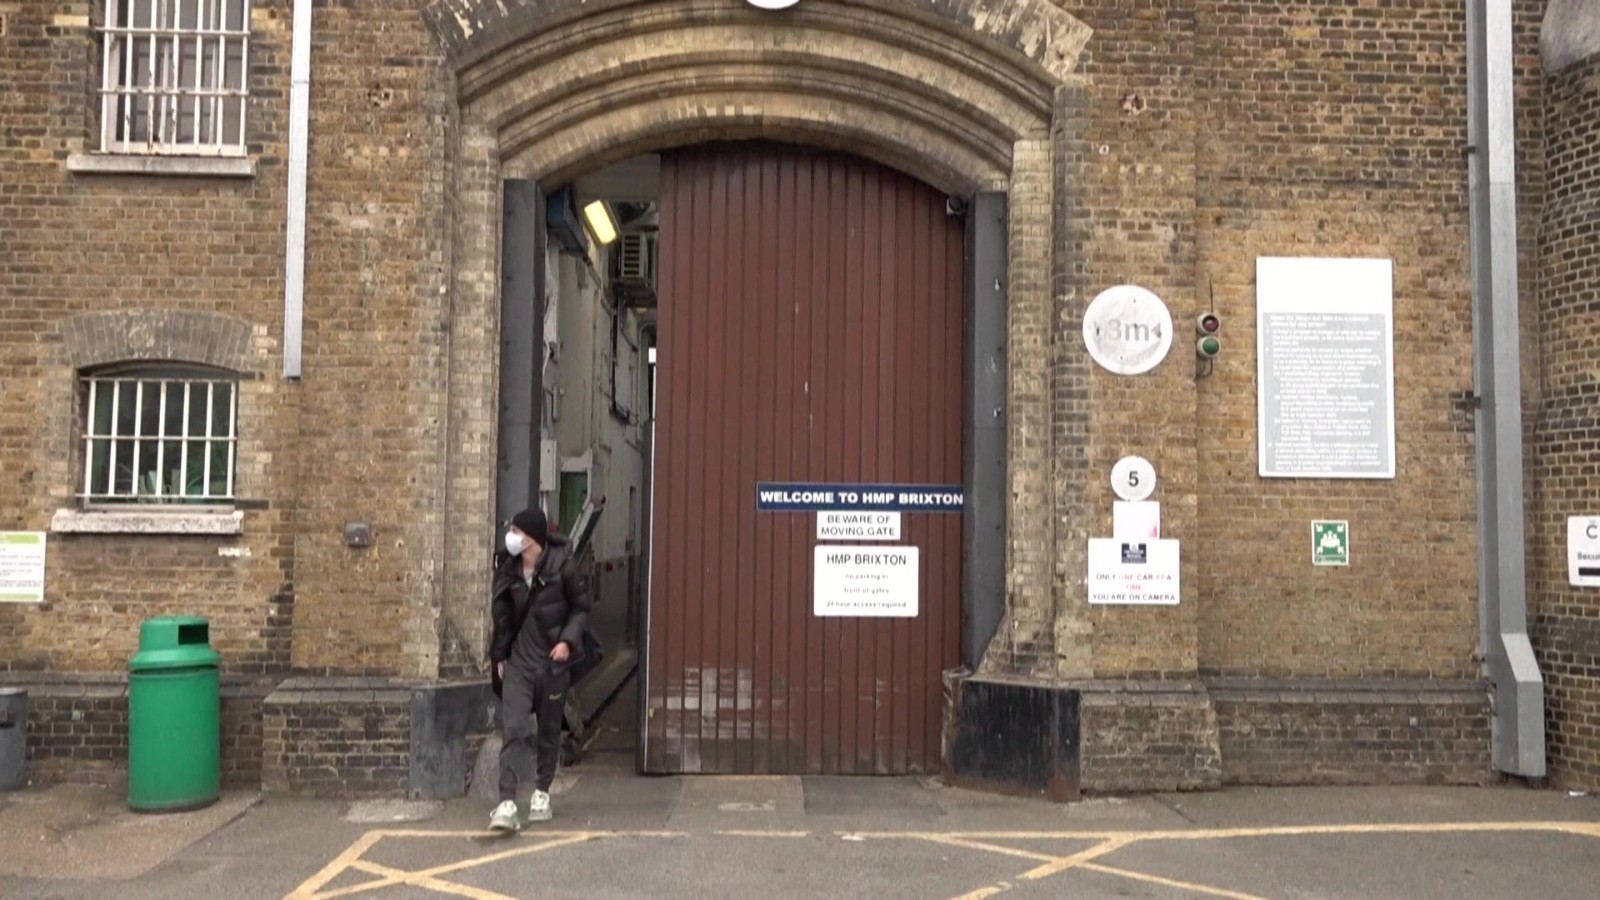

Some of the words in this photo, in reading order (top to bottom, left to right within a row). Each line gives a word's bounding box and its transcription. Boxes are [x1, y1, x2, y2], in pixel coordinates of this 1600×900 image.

[1128, 470, 1139, 487] 5
[760, 490, 834, 504] WELCOME
[838, 491, 858, 504] TO
[862, 491, 894, 505] HMP
[898, 492, 964, 506] BRIXTON
[827, 514, 873, 525] BEWARE
[876, 514, 891, 525] OF
[821, 526, 864, 536] MOVING
[867, 526, 895, 537] GATE
[826, 553, 851, 565] HMP
[854, 554, 907, 566] BRIXTON
[1137, 573, 1153, 581] CAR
[1166, 573, 1172, 581] A
[1093, 593, 1109, 601] YOU
[1111, 593, 1126, 601] ARE
[1128, 593, 1140, 601] ON
[1142, 593, 1176, 601] CAMERA
